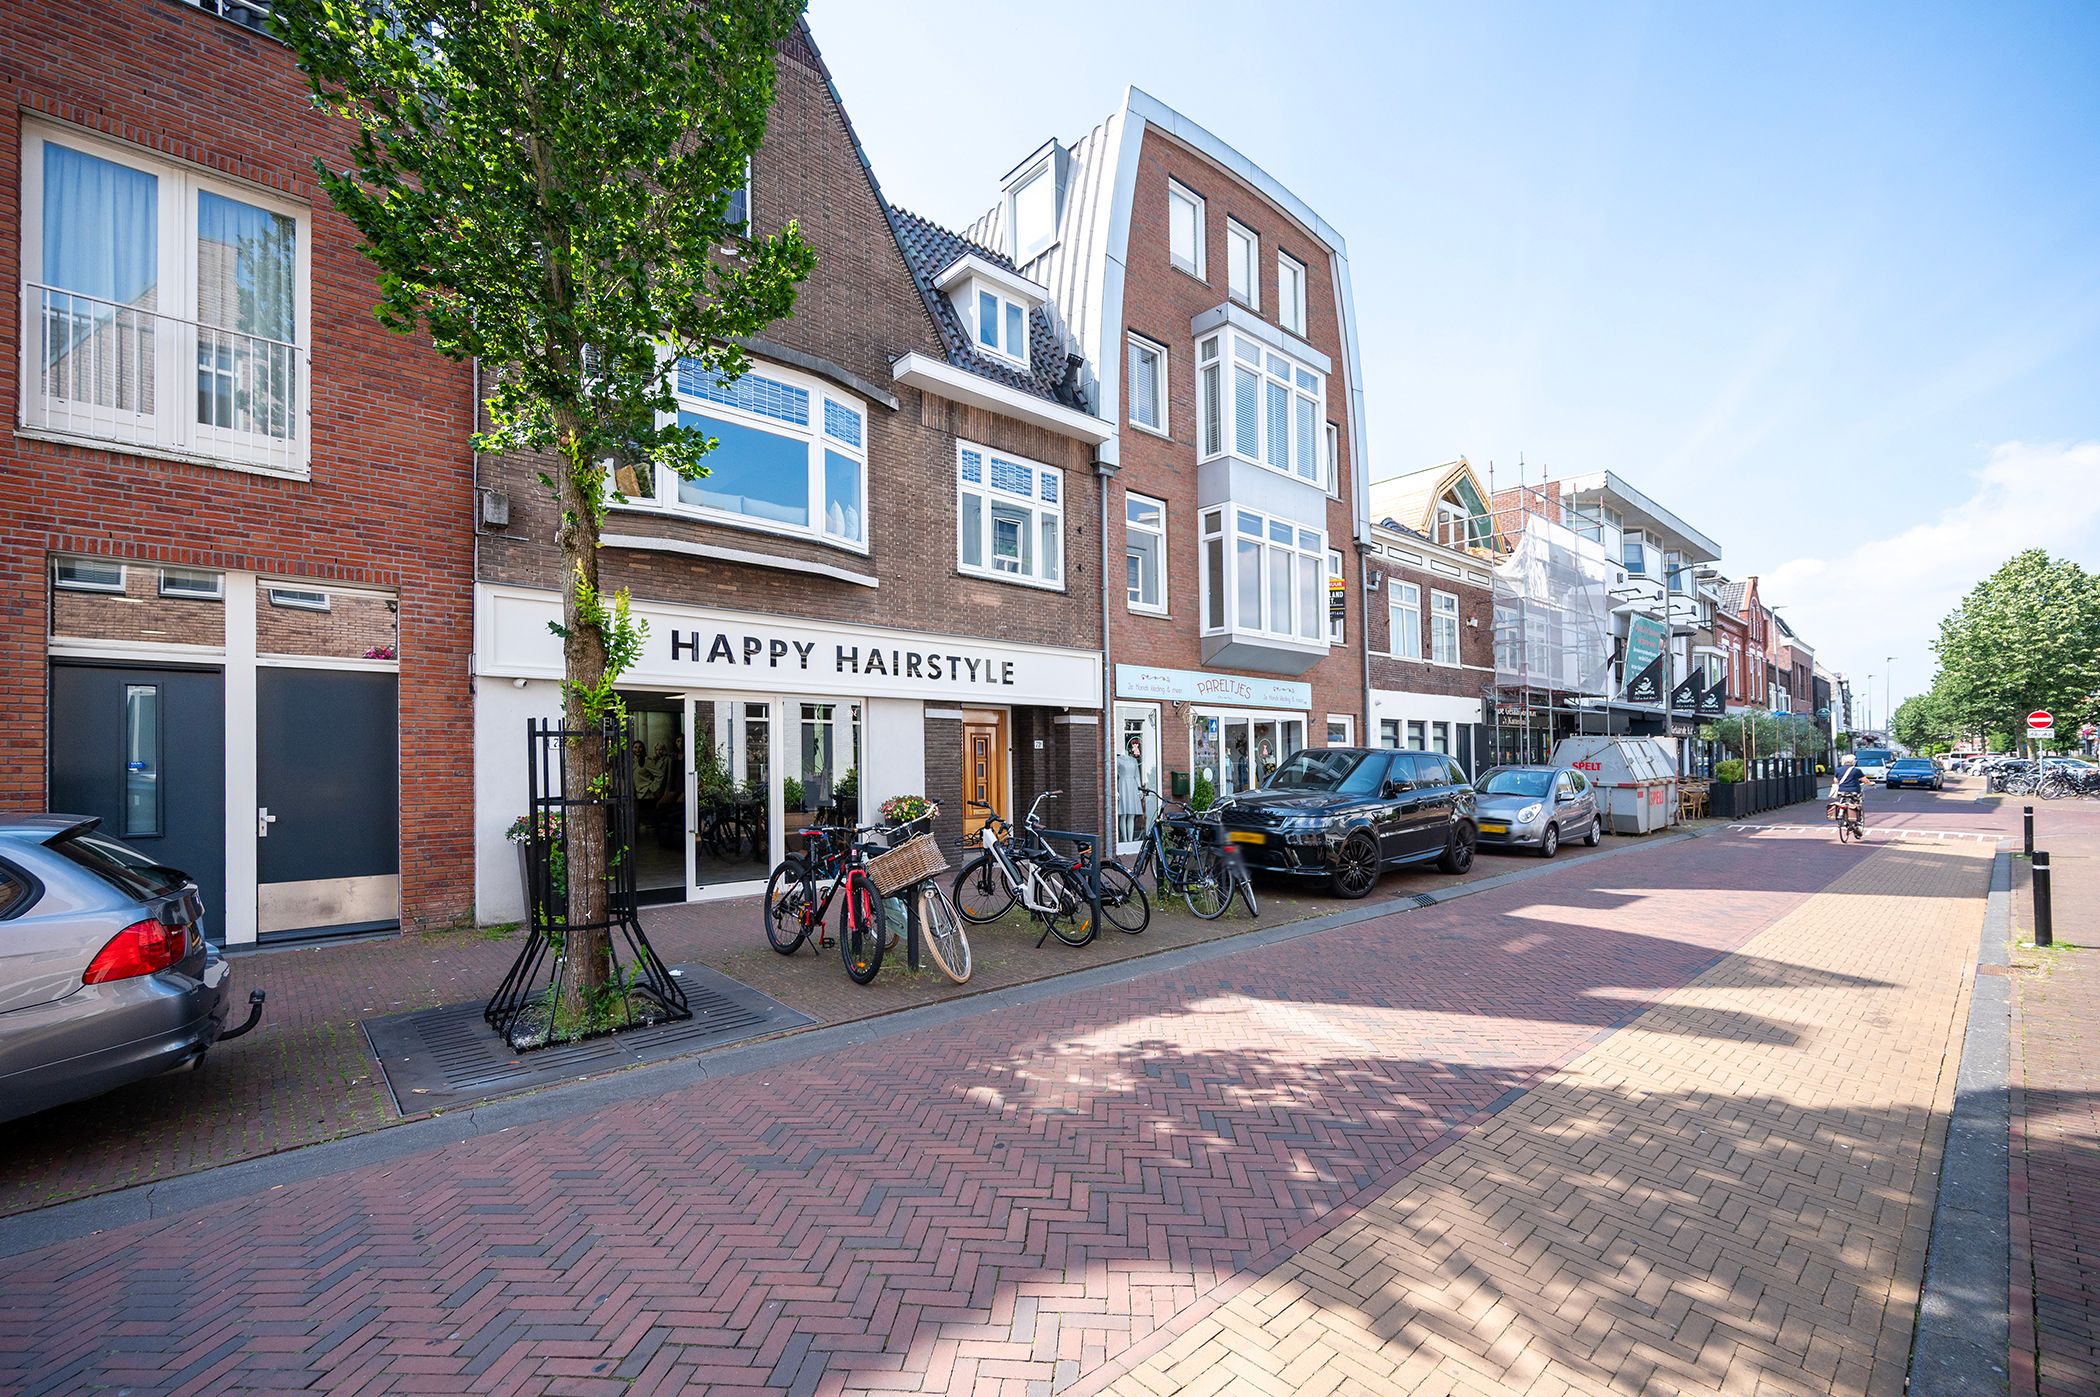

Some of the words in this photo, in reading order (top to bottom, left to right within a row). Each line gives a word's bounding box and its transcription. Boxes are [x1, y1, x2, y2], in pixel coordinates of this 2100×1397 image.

[671, 629, 816, 670] HAPPY
[836, 645, 1014, 686] HAIRSTYLE
[1197, 679, 1252, 700] PARELTJES
[1572, 761, 1601, 771] SPELT
